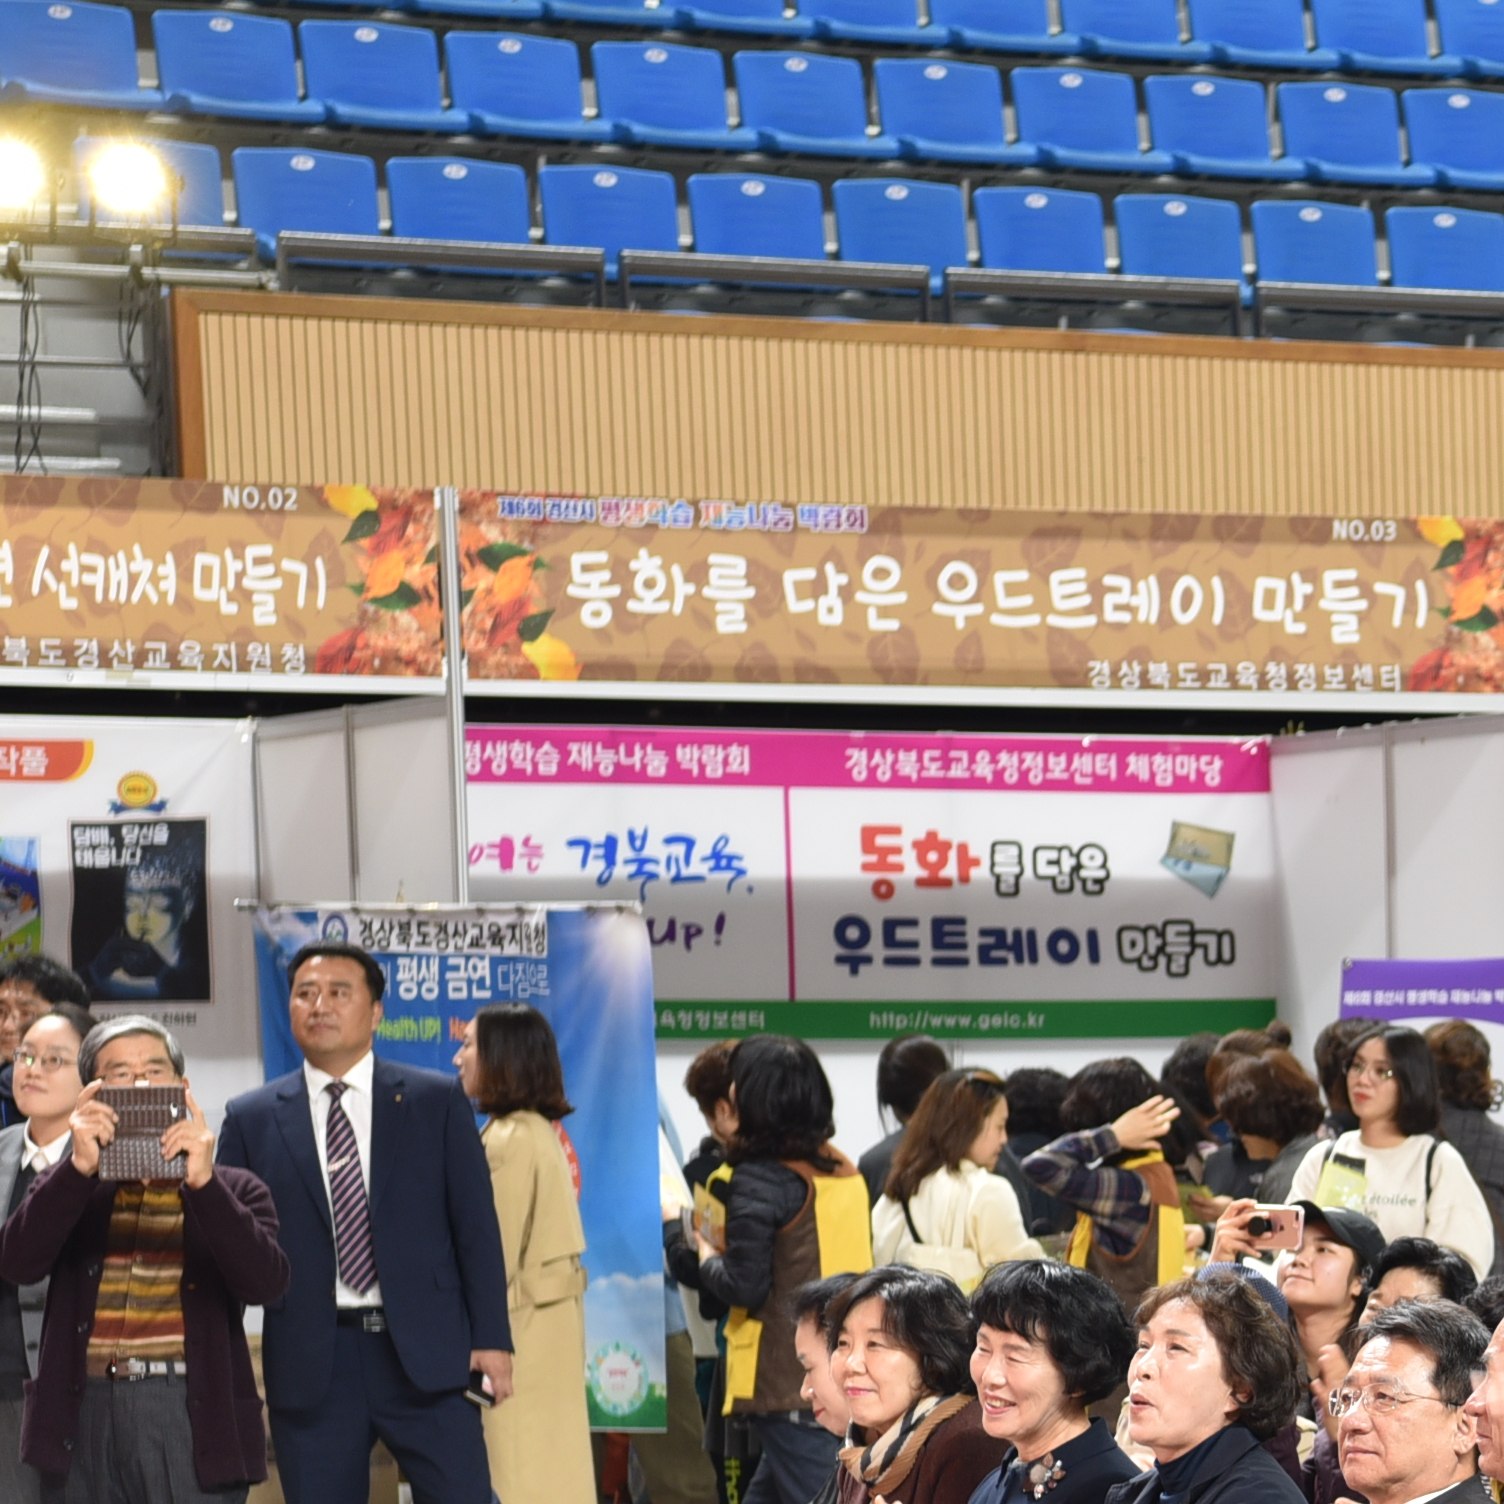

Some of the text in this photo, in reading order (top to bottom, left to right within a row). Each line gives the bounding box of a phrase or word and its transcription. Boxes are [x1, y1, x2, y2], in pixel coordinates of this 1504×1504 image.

[223, 486, 298, 511] NO.02
[599, 497, 694, 529] 평생학습
[699, 501, 794, 532] 재능나눔
[797, 503, 868, 533] 박람회
[1332, 519, 1397, 542] NO.03
[32, 541, 176, 610] 선캐쳐
[194, 543, 326, 626] 만들기
[566, 547, 1429, 644] 동화를 담은 우드트레이 만들기
[1087, 660, 1401, 692] 경상북도교육청정보센터
[465, 739, 751, 778] 평생학습 재능나눔 박람회
[845, 747, 1223, 787] 경상북도교육청정보센터 체험마당
[1032, 842, 1110, 896] 담은
[833, 913, 1236, 980] 우드트레이 만들기
[396, 953, 440, 1001] 평생
[445, 953, 492, 1000] 금연
[654, 1009, 766, 1032] 육청정보센터
